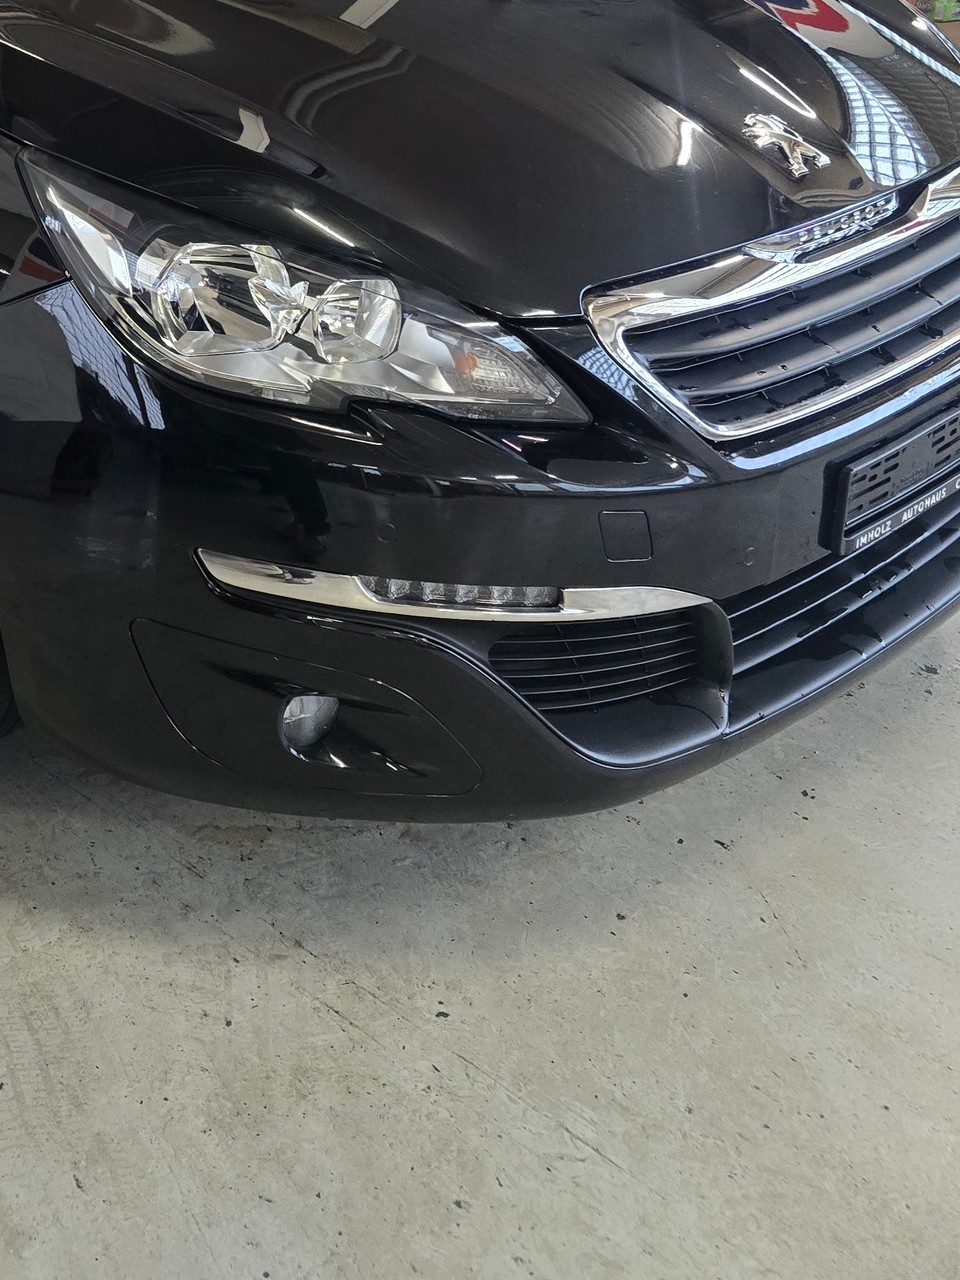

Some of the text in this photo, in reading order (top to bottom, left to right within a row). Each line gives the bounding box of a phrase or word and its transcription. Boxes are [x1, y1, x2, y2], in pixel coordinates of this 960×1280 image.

[798, 200, 886, 245] PEUGEOT
[856, 488, 947, 549] IMHOLZ AUTOHAUS
